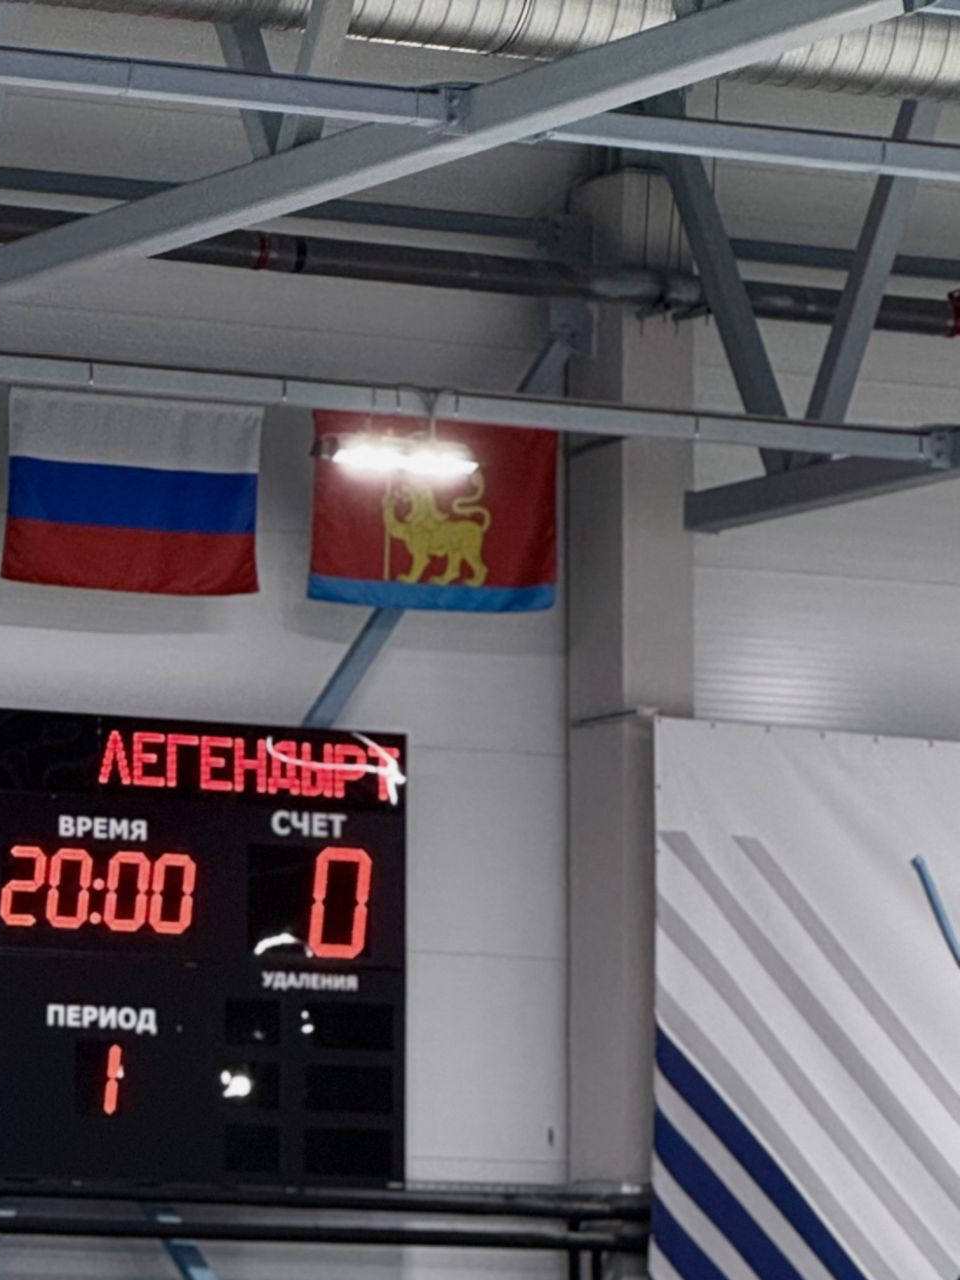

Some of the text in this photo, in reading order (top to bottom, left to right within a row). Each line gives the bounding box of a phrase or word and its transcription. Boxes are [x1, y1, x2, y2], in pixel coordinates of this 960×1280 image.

[58, 816, 148, 842] ВРЕМЯ
[271, 810, 347, 838] СЧЕТ
[0, 845, 197, 935] 20:00
[308, 846, 373, 959] 0
[262, 972, 358, 991] УДАЛЕНИЯ
[46, 1004, 158, 1035] ПЕРИОД
[103, 1044, 123, 1115] 1
